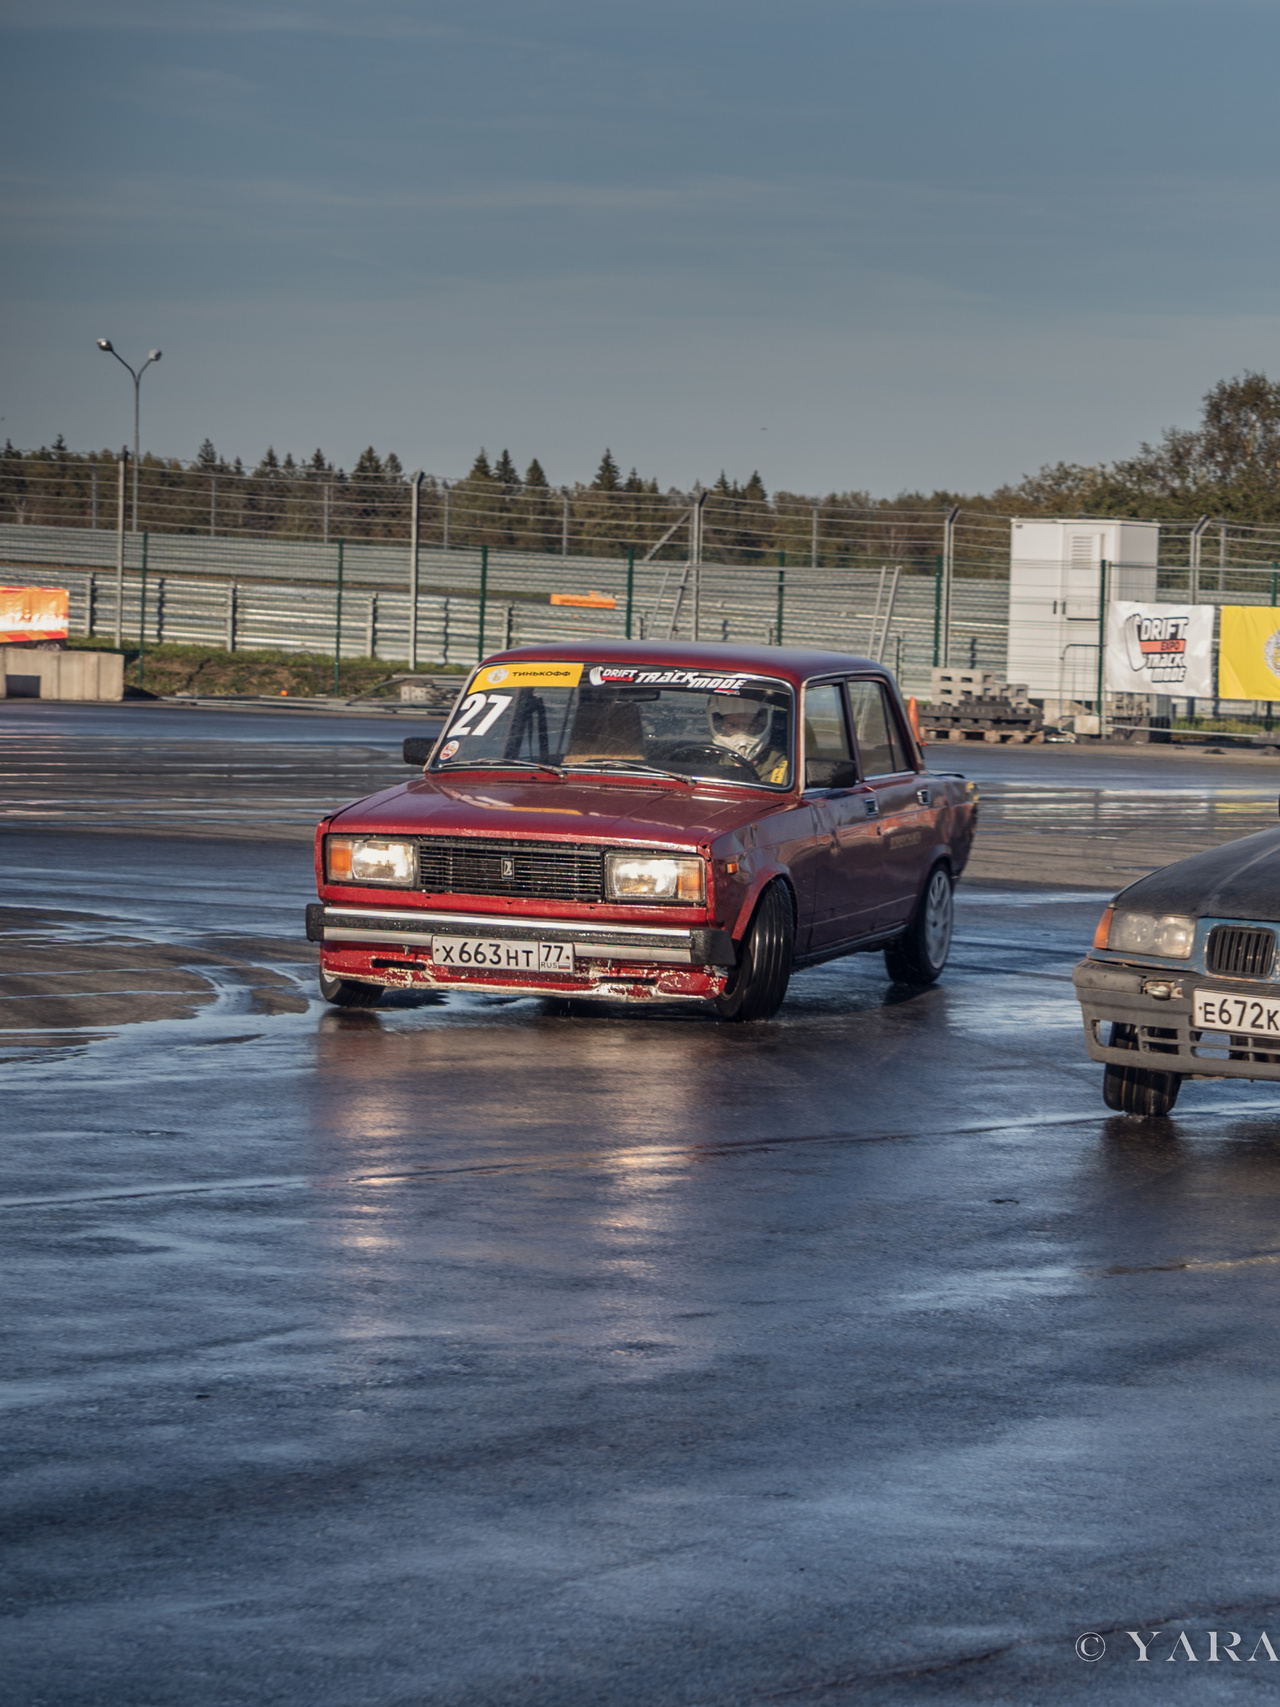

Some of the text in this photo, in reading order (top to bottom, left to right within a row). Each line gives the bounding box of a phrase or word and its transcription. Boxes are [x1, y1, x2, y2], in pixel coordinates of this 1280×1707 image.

[1140, 616, 1188, 640] DRIFT
[1161, 641, 1180, 651] EXPO
[602, 668, 639, 677] DRIFT
[446, 692, 514, 738] 27
[542, 945, 564, 962] 77
